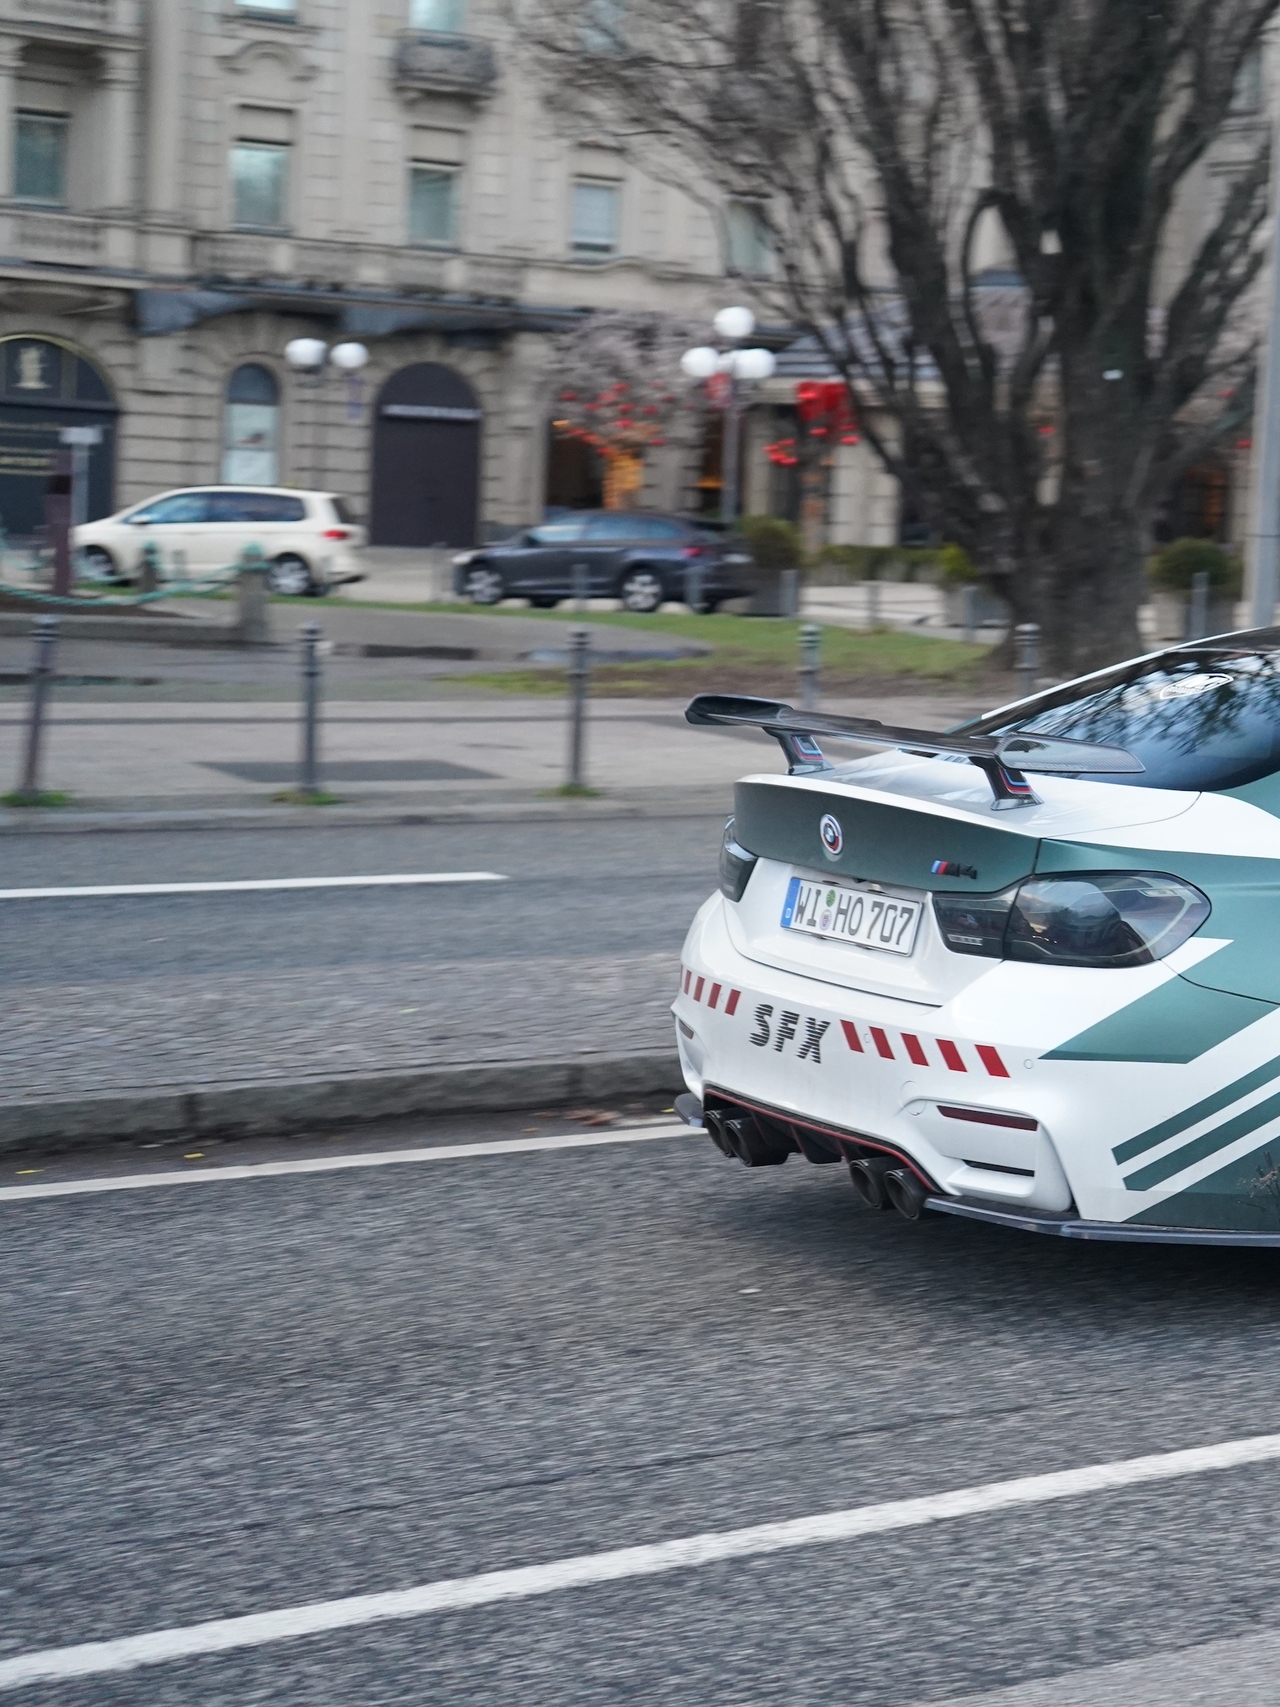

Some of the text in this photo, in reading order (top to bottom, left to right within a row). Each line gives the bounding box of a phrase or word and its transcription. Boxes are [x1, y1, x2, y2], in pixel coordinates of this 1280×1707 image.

[794, 885, 915, 945] WI HO 707
[748, 1003, 831, 1064] SFX
